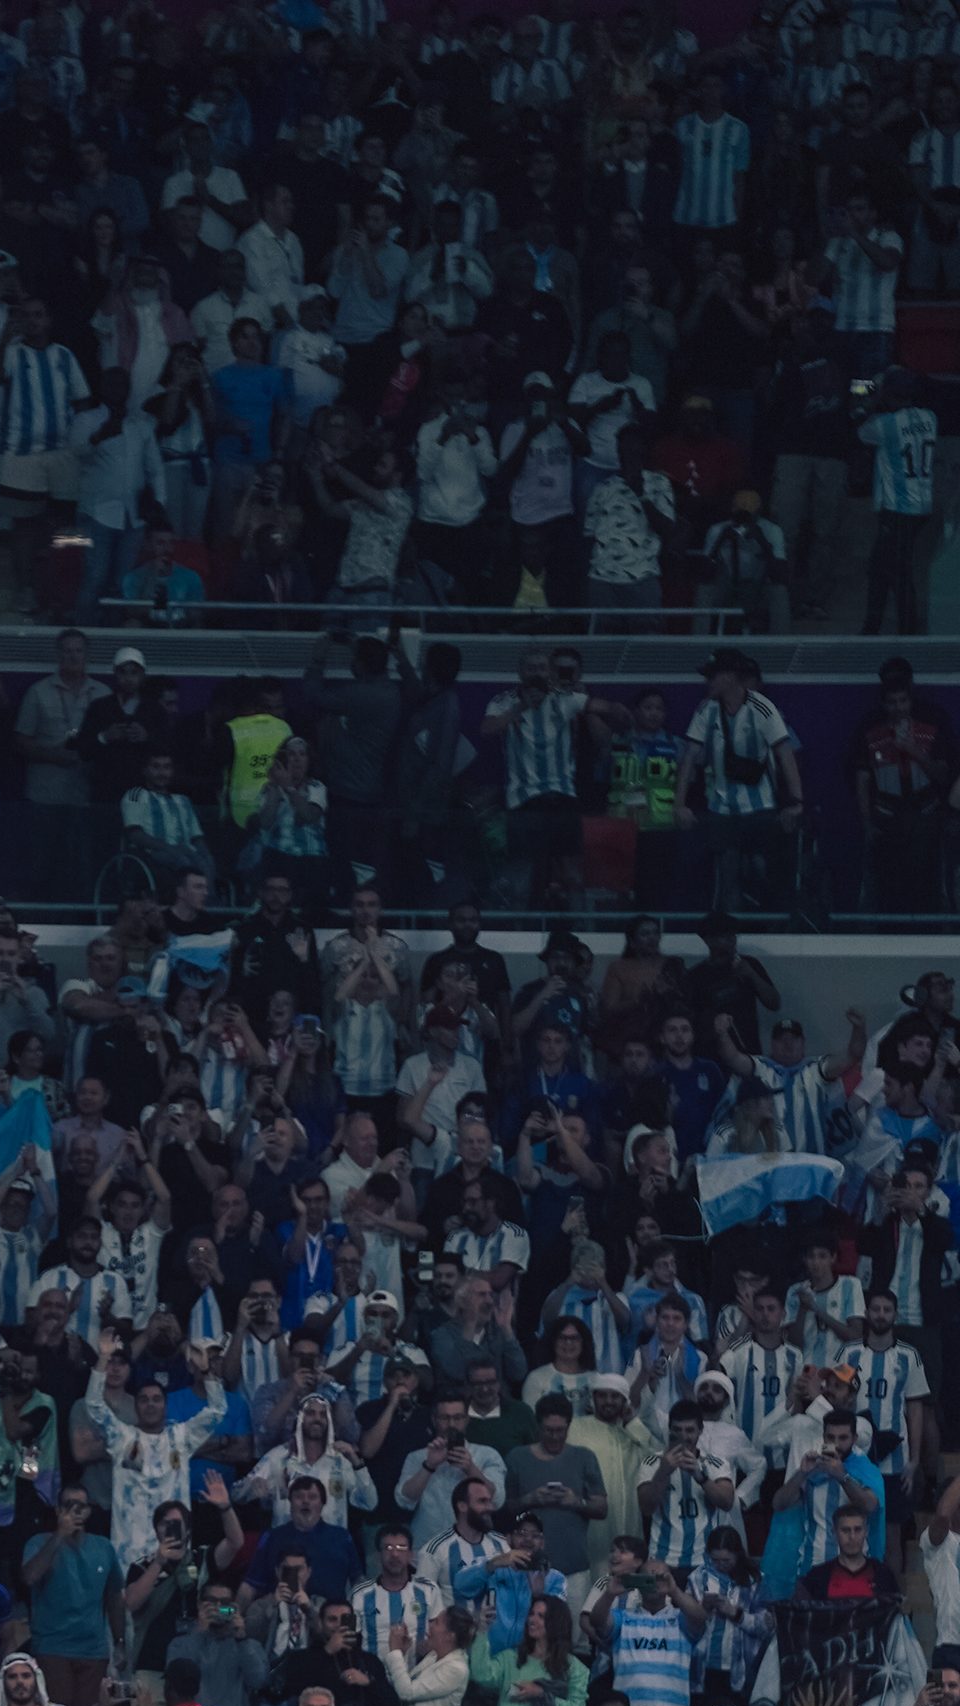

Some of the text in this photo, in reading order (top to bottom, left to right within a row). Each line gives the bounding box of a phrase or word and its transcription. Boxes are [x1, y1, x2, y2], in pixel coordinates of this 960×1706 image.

[762, 1376, 780, 1397] 10
[865, 1378, 888, 1400] 10
[678, 1498, 699, 1520] 10
[632, 1637, 668, 1650] VISA
